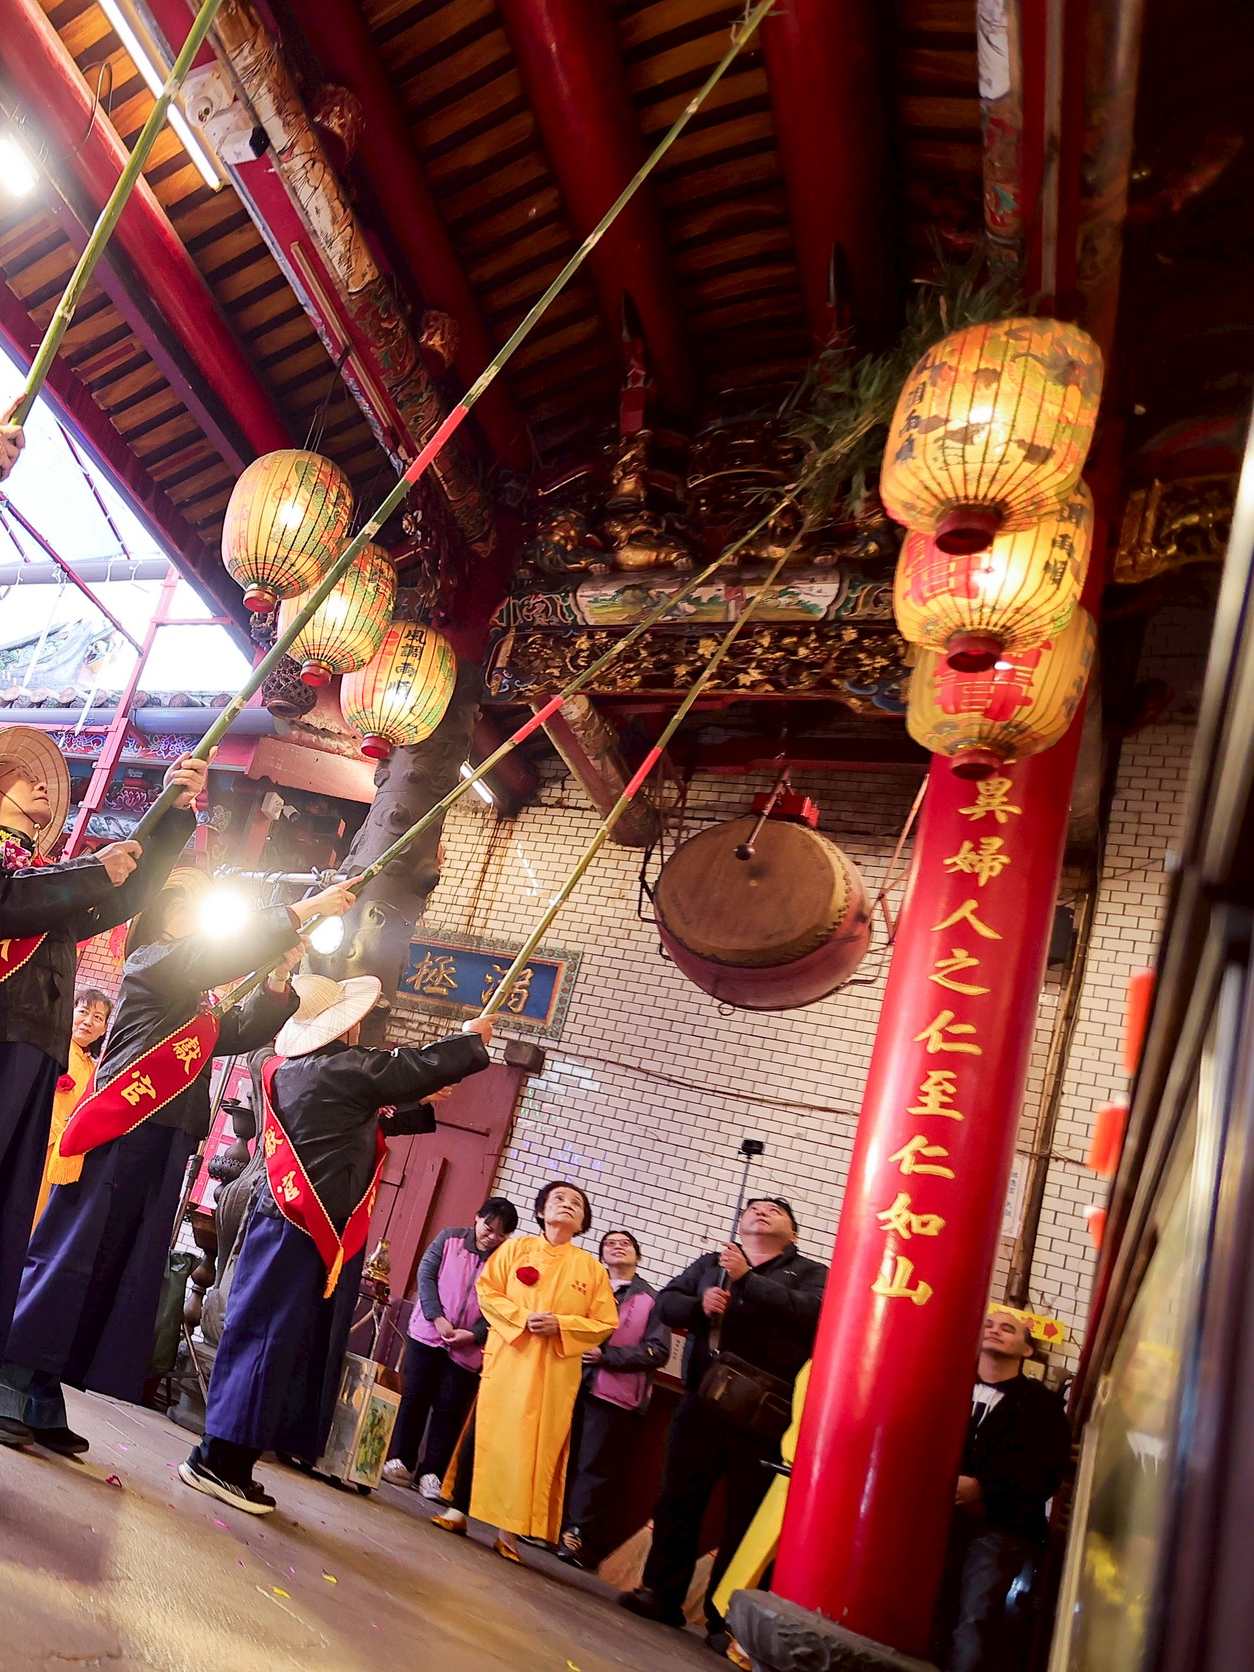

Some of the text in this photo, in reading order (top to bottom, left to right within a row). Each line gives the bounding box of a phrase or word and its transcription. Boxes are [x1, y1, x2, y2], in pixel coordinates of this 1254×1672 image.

[387, 628, 427, 699] 風調雨順
[870, 776, 1023, 1306] 異婦人之仁至仁如山
